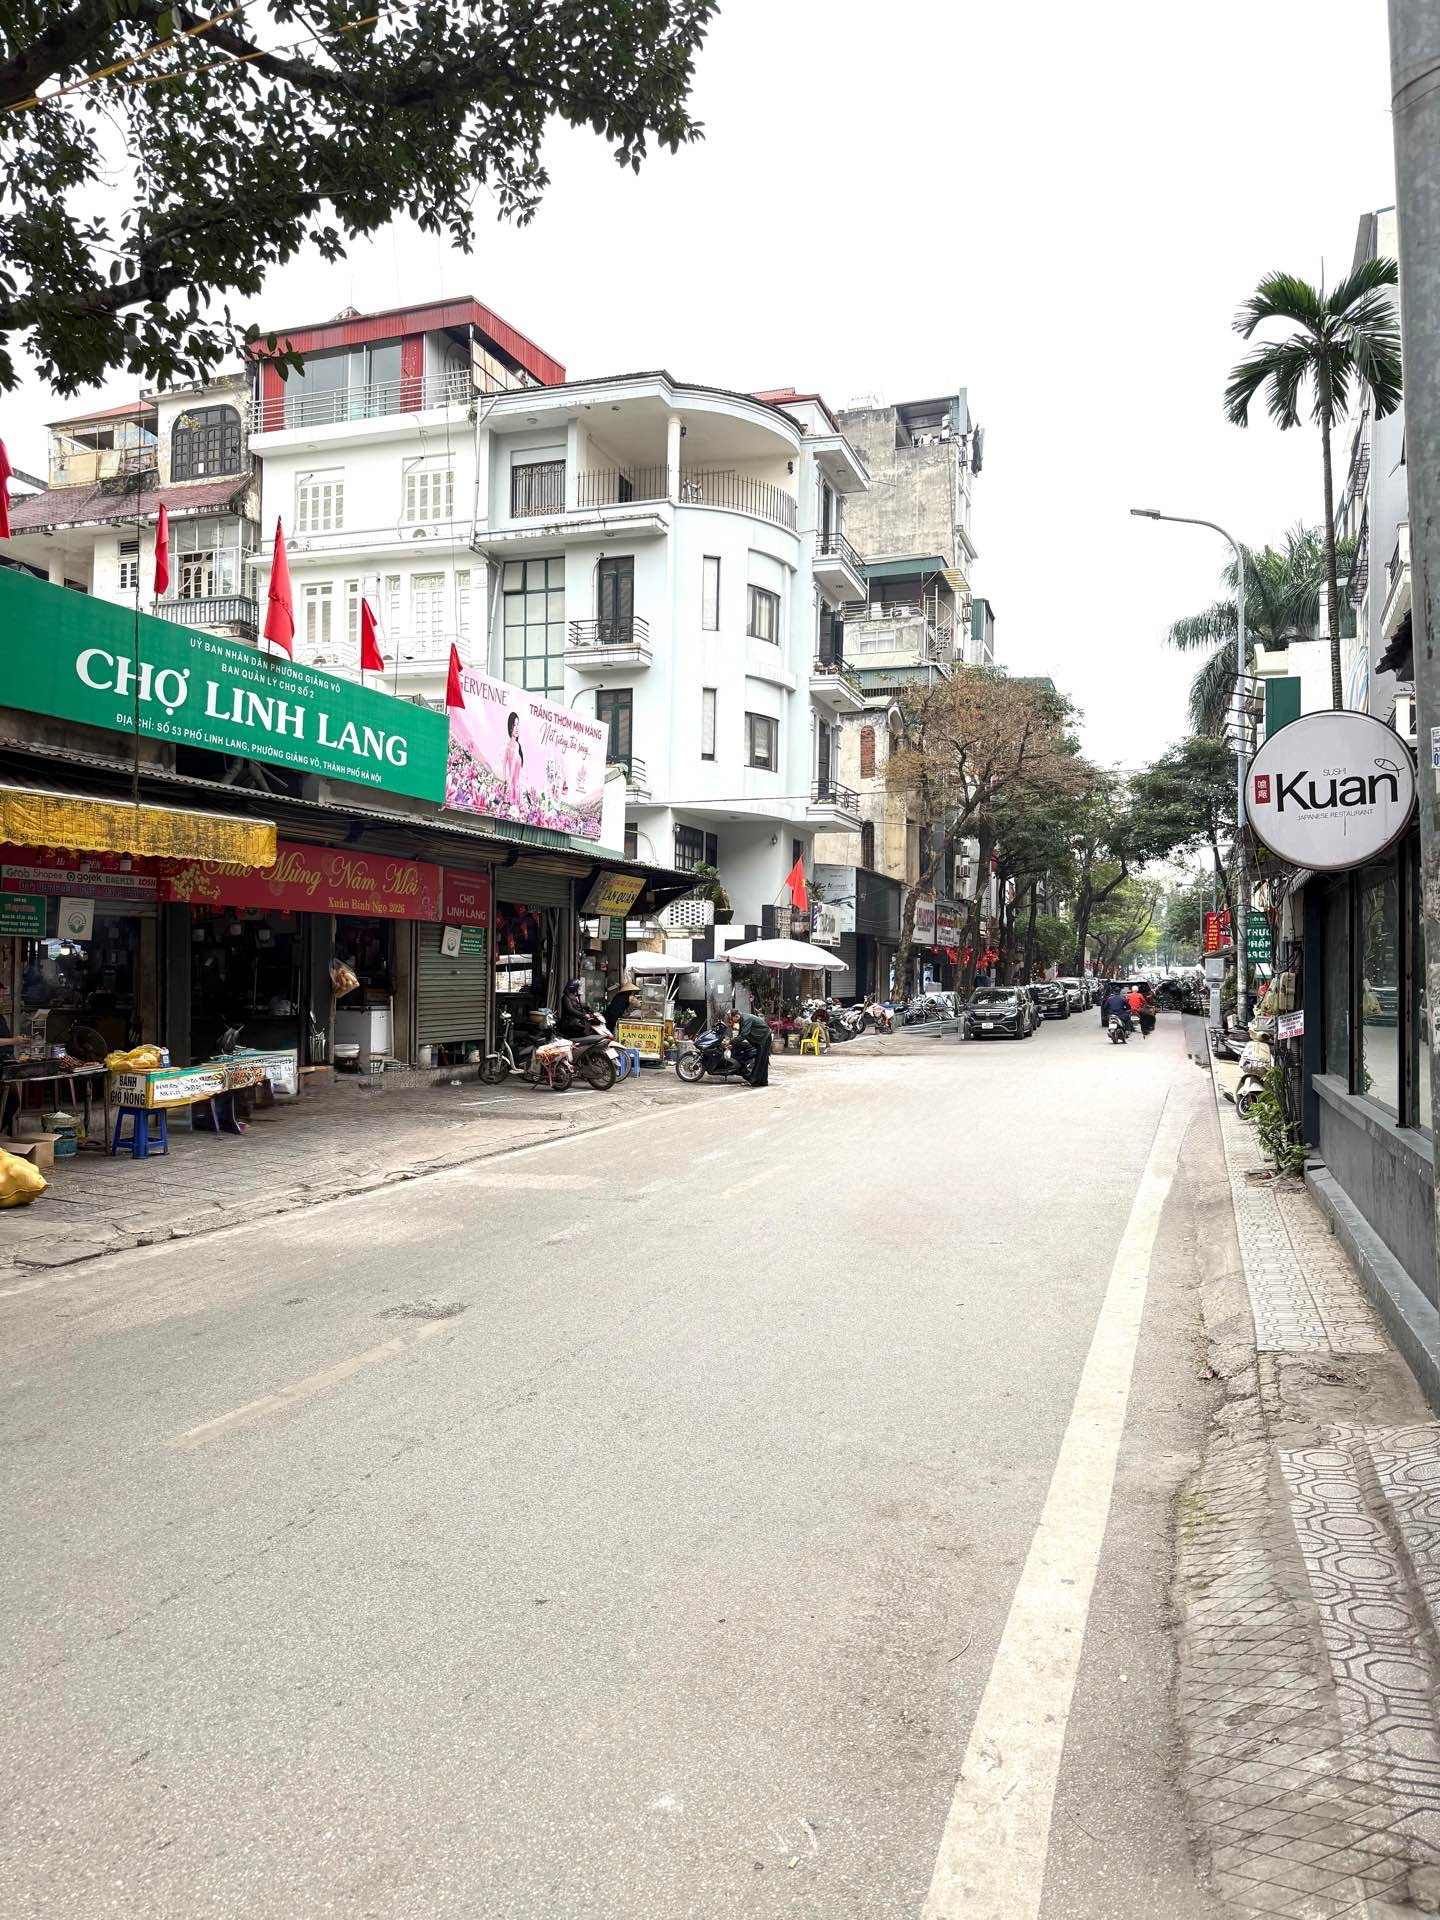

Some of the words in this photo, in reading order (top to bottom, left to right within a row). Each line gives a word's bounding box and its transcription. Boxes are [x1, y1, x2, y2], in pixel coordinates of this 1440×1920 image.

[204, 643, 223, 655] BAN
[225, 649, 249, 664] NHÂN
[251, 655, 269, 670] DÂN
[270, 662, 304, 681] PHƯỜNG
[221, 663, 240, 675] BAN
[241, 668, 265, 684] QUẢN
[267, 675, 278, 687] LÝ
[279, 681, 296, 694] CHỢ
[297, 686, 309, 697] SỐ
[309, 690, 315, 699] 2
[76, 648, 191, 716] CHỢ
[204, 680, 306, 739] LINH
[317, 712, 408, 766] LANG
[529, 703, 553, 723] TRẮNG
[553, 712, 572, 730] THƠM
[116, 713, 133, 727] ĐỊA
[156, 720, 170, 734] SỐ
[171, 726, 182, 736] 53
[183, 728, 203, 741] PHỐ
[204, 733, 224, 745] LINH
[225, 738, 250, 752] LANG,
[251, 743, 284, 759] PHƯỜNG
[323, 761, 346, 777] THÀNH
[346, 766, 360, 778] PHỐ
[361, 769, 371, 780] HÀ
[370, 772, 382, 783] NỘI
[1322, 767, 1347, 777] SUSHI
[1276, 770, 1399, 812] Kuan
[1296, 811, 1329, 821] JAPANESE
[1329, 808, 1373, 819] RESTAURANT
[77, 872, 102, 883] gojek
[260, 851, 322, 896] Mừng
[328, 856, 377, 891] Năm
[328, 897, 350, 910] Xuân
[447, 907, 466, 919] LINH
[466, 909, 486, 921] LANG
